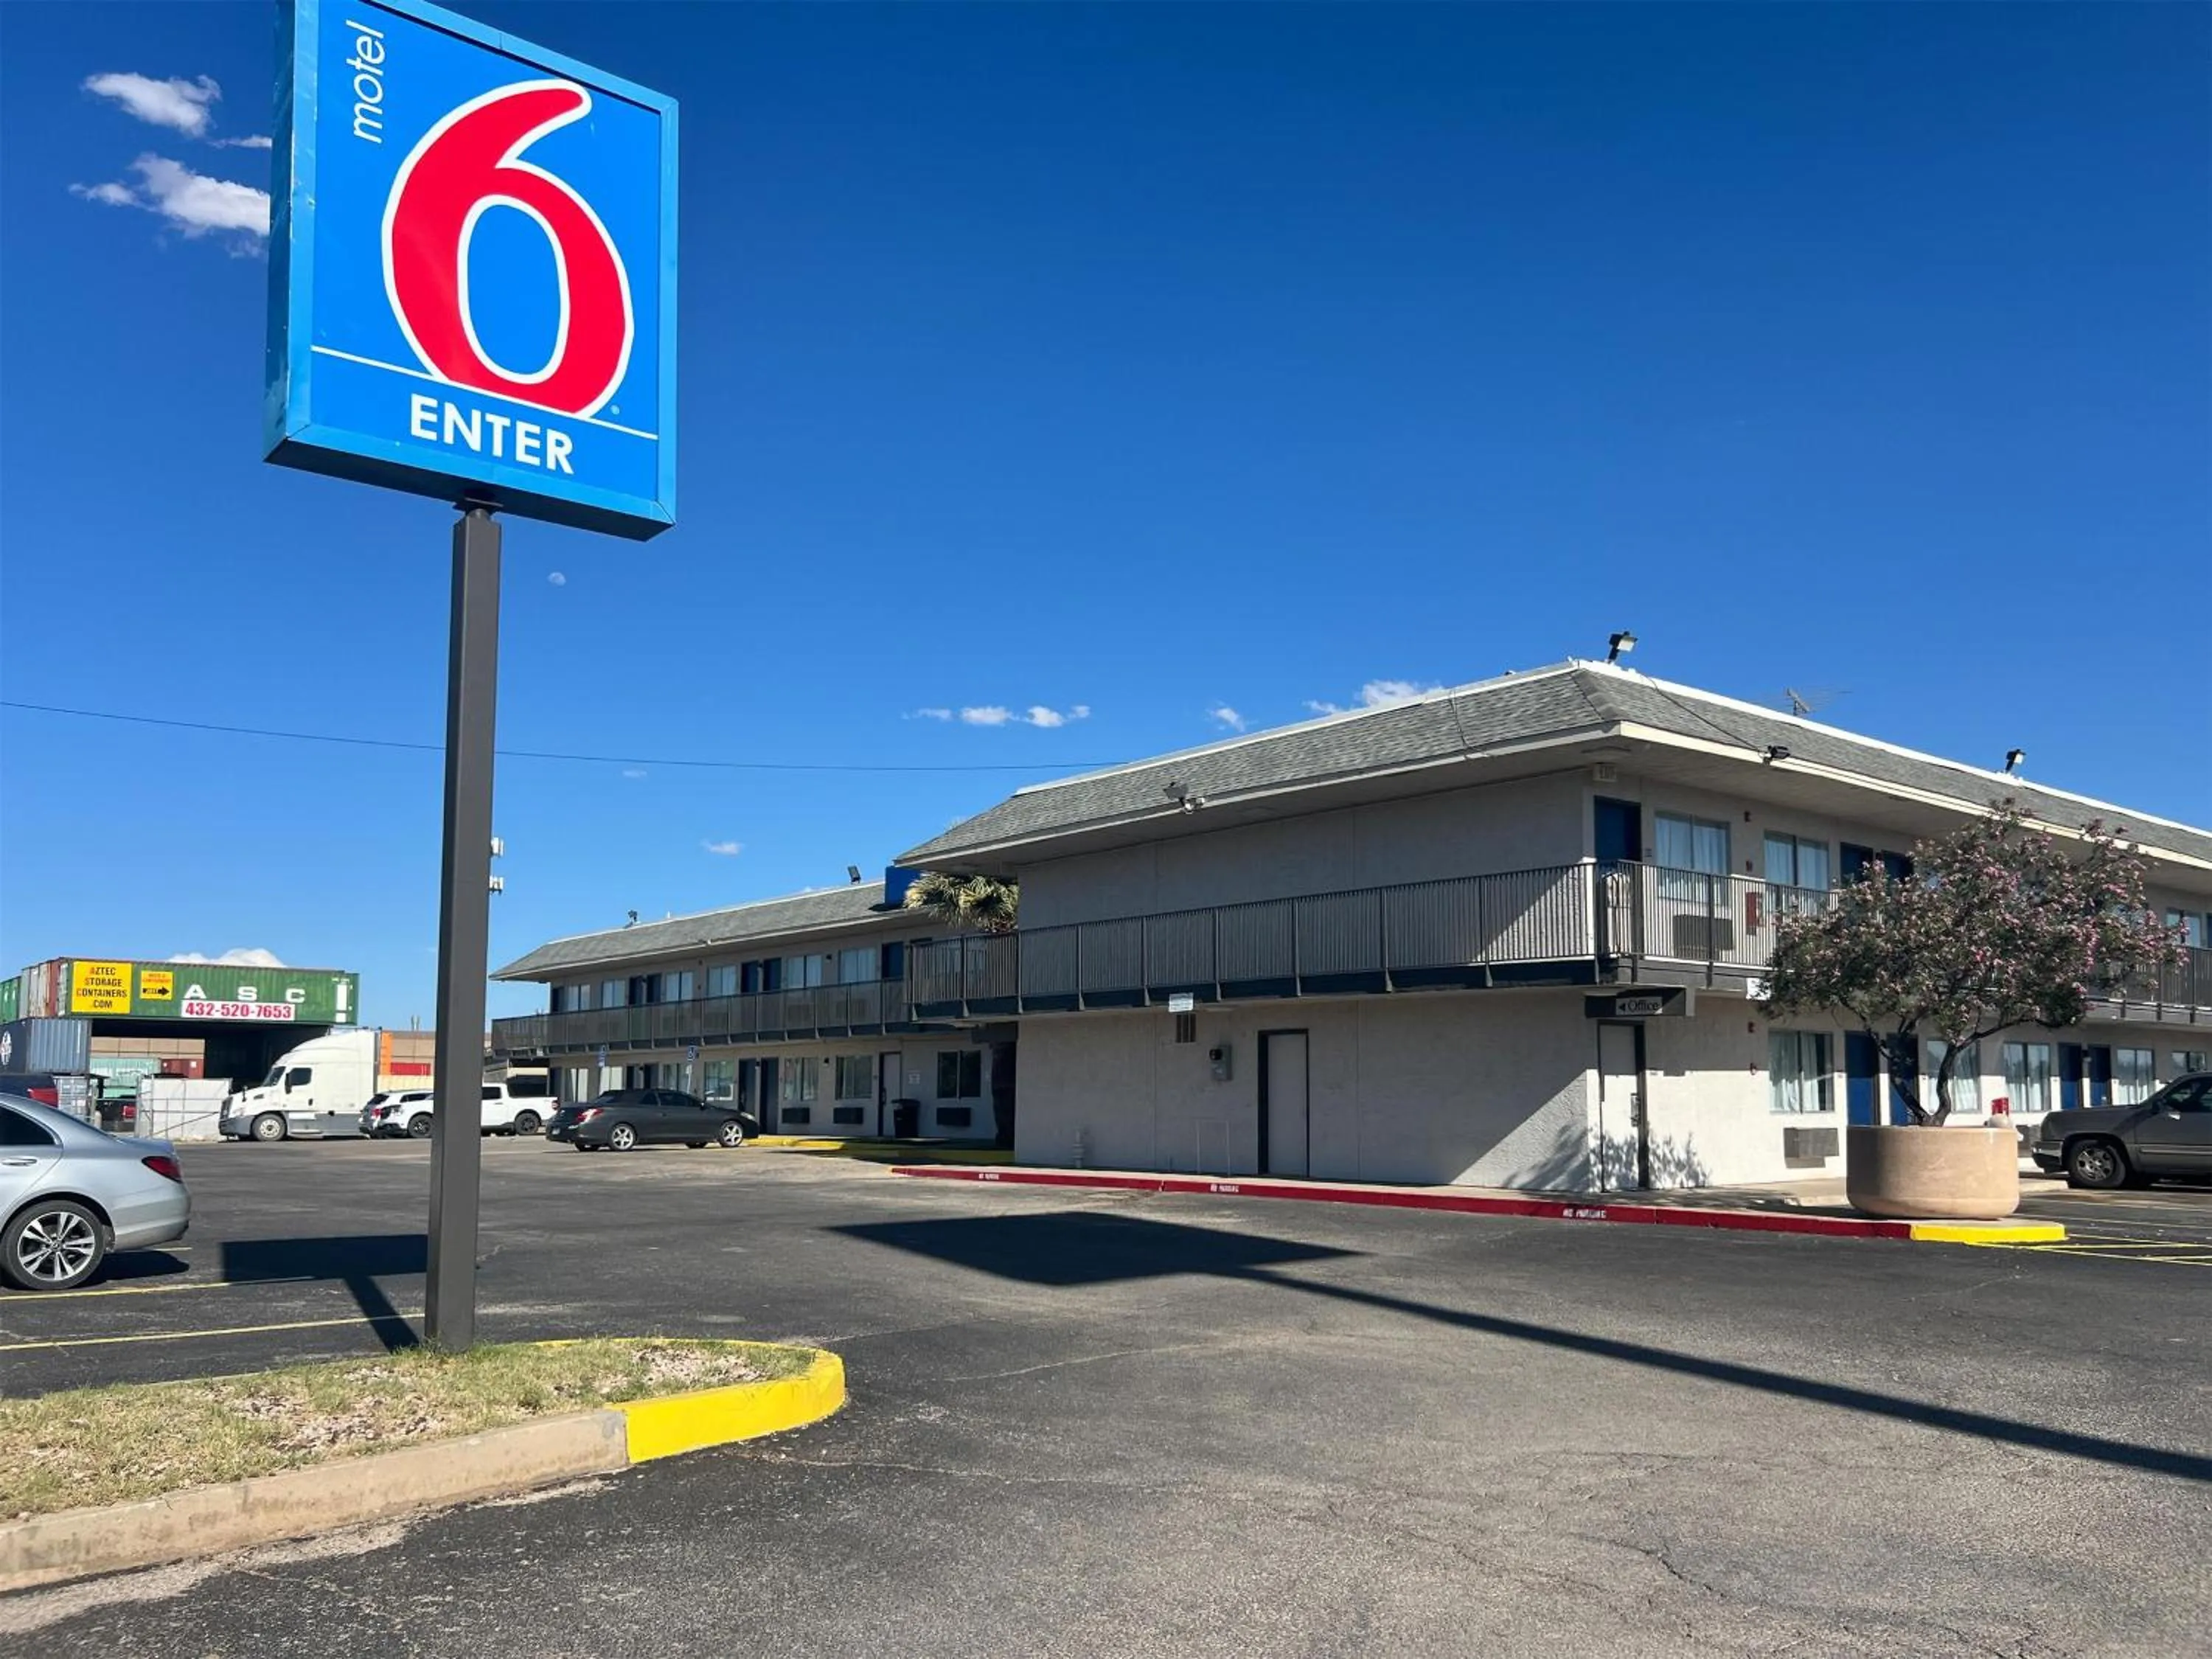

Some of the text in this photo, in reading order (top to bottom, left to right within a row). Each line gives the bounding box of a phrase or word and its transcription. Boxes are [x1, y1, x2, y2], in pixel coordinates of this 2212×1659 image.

[346, 20, 385, 144] motel
[381, 79, 634, 420] 6
[409, 393, 574, 474] ENTER
[90, 967, 116, 975] AZTEC
[84, 978, 122, 987] STORAGE
[76, 988, 128, 998] CONTAINERS
[185, 1003, 291, 1018] 432-520-7653
[1628, 999, 1660, 1012] Office
